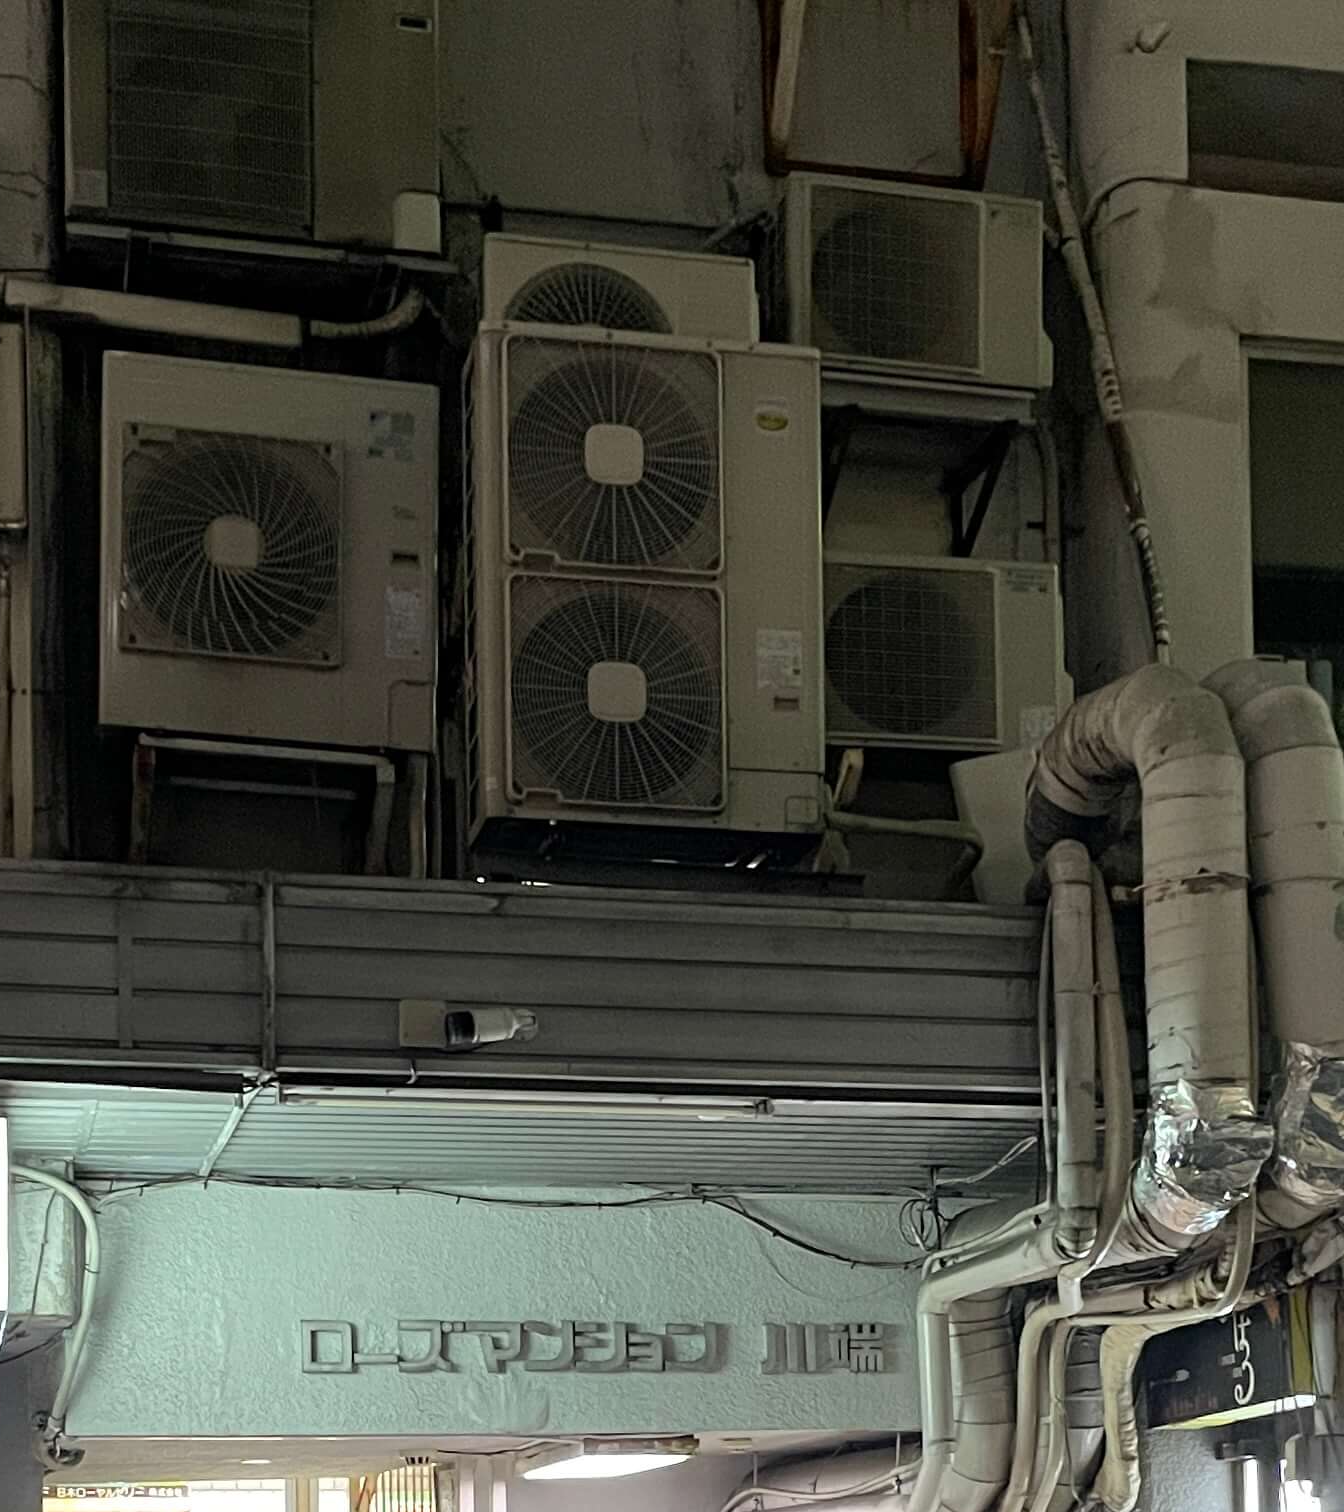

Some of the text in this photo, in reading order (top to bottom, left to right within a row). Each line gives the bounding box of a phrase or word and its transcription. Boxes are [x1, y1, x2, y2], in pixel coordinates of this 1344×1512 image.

[300, 1318, 890, 1374] ローズマンション 川端
